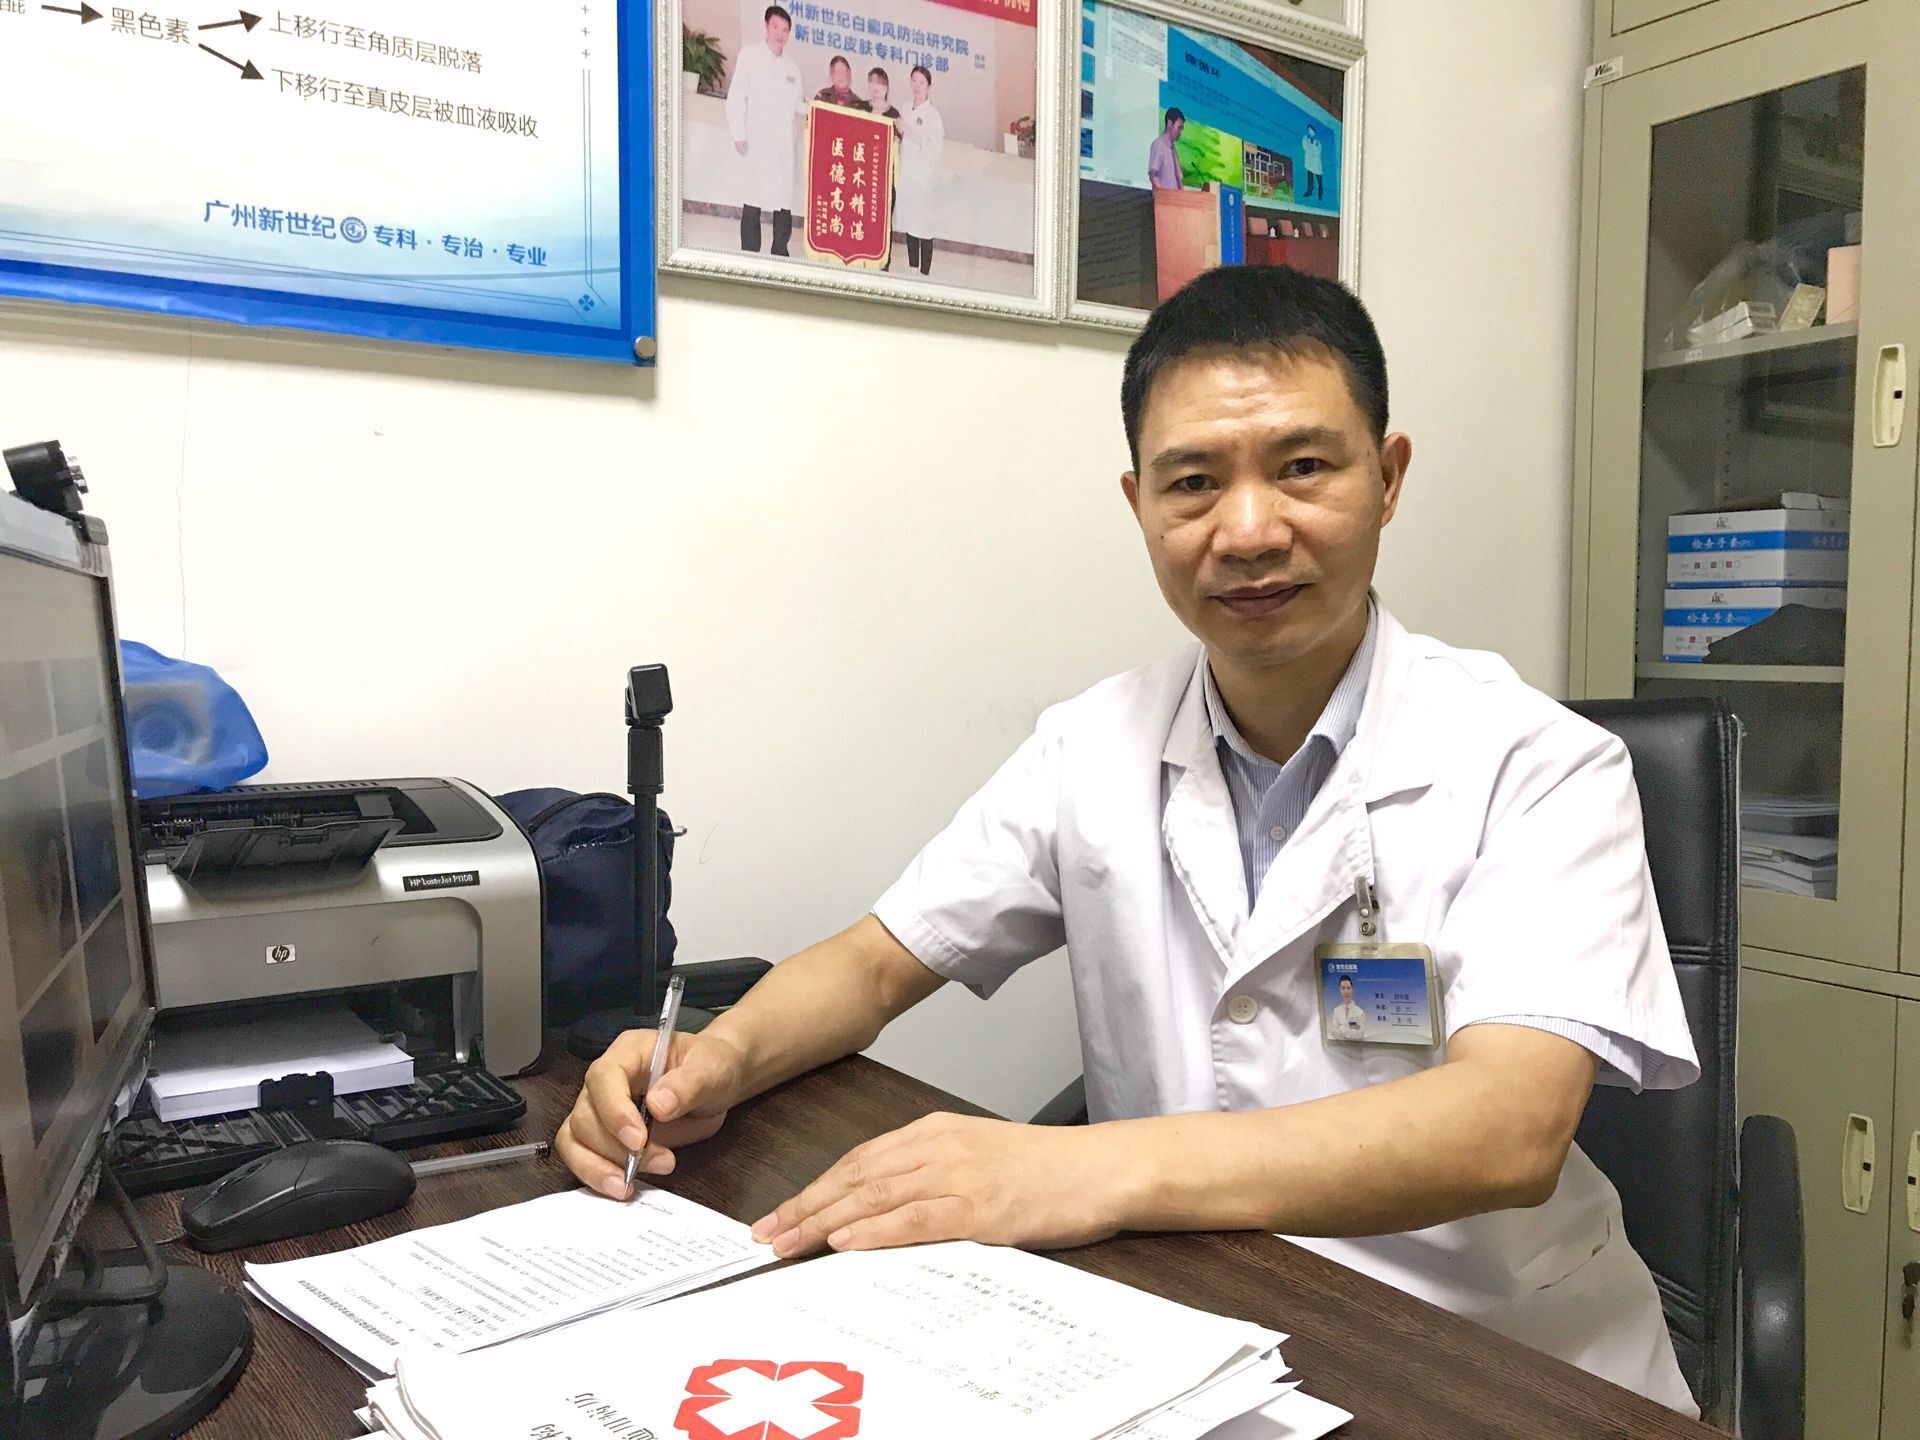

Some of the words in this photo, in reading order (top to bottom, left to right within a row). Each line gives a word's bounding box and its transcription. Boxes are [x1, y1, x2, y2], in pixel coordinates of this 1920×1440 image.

[111, 7, 190, 44] 黑色素
[268, 9, 484, 75] 上移行至角质层脱落
[794, 23, 950, 73] 新世纪皮肤专科门诊部
[270, 68, 540, 140] 下移行至真皮层被血液吸收
[829, 137, 846, 237] 医德高尚
[203, 199, 337, 242] 广州新世纪
[408, 878, 421, 887] HP
